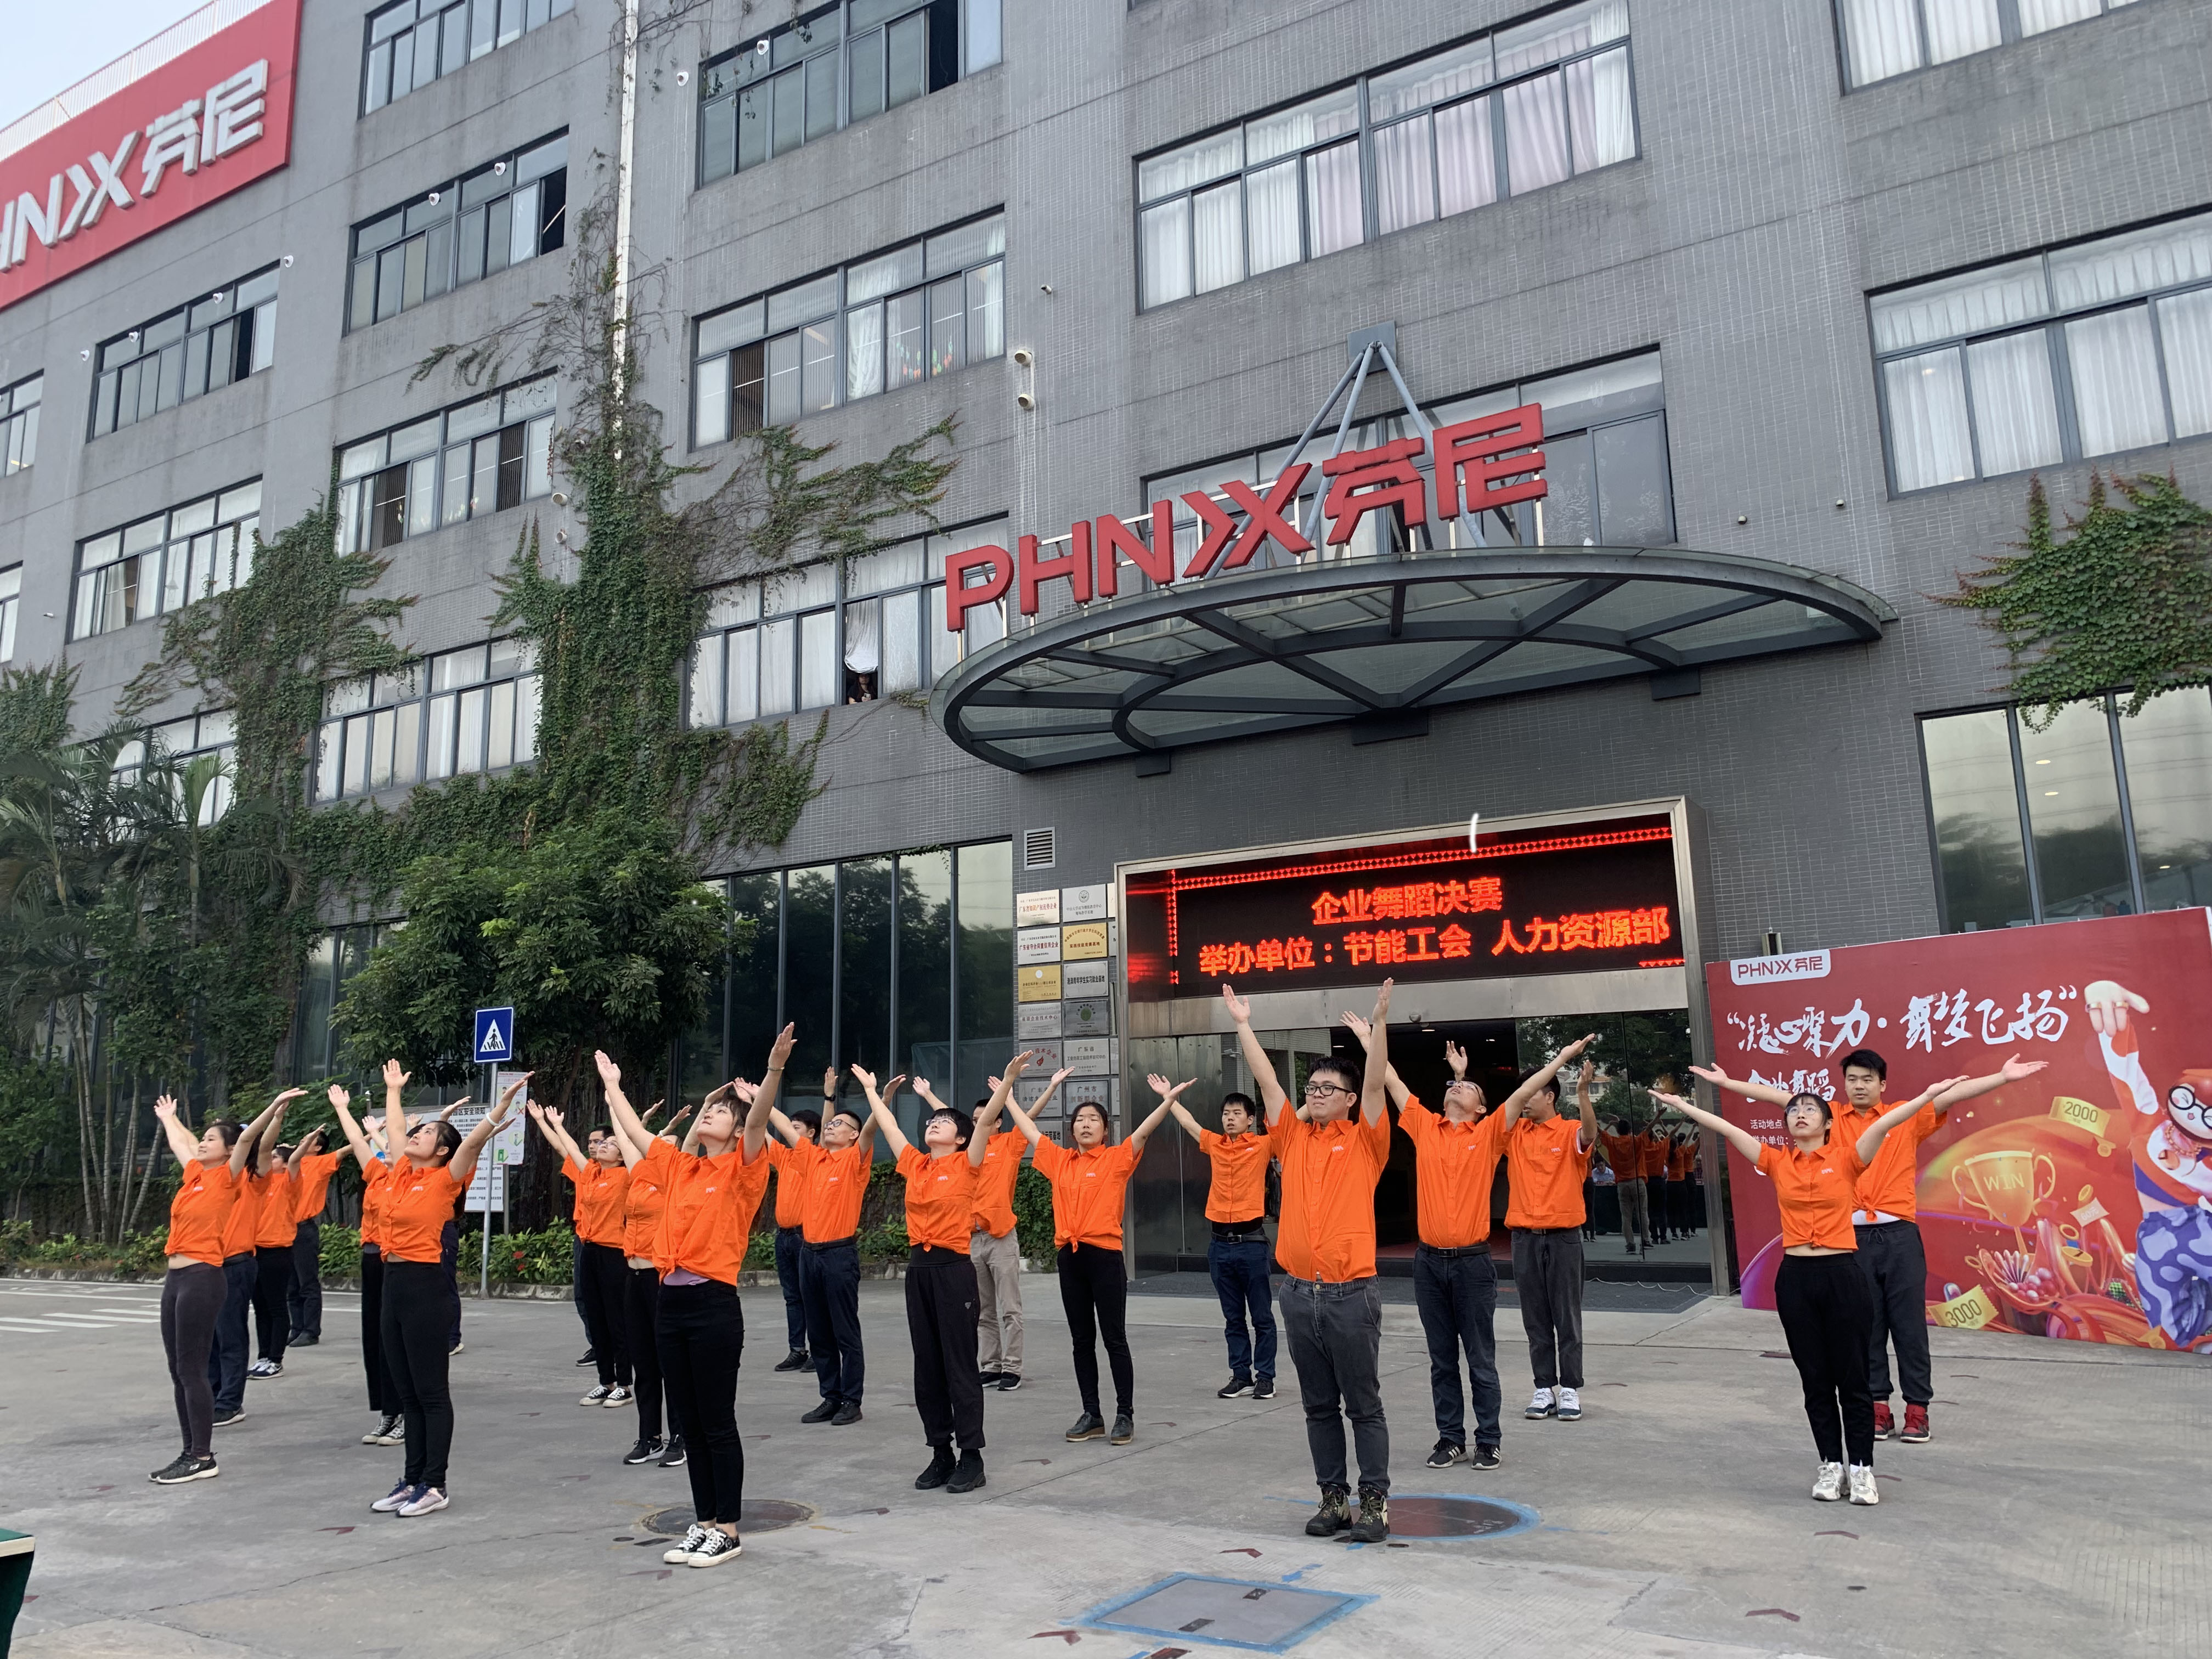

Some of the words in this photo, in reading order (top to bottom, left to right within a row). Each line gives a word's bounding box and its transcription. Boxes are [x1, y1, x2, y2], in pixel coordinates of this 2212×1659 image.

[140, 59, 268, 198] 芬尼
[1323, 403, 1548, 546] 芬尼
[1312, 878, 1502, 926] 企业舞蹈决赛
[1492, 907, 1671, 957] 人力资源部
[1794, 956, 1823, 972] 芬尼
[450, 1107, 486, 1116] 园区安全须知
[1750, 1119, 1783, 1129] 活动地点
[2064, 1101, 2098, 1123] 2000
[1983, 1172, 2025, 1191] WIN
[1945, 1299, 1982, 1327] 3000
